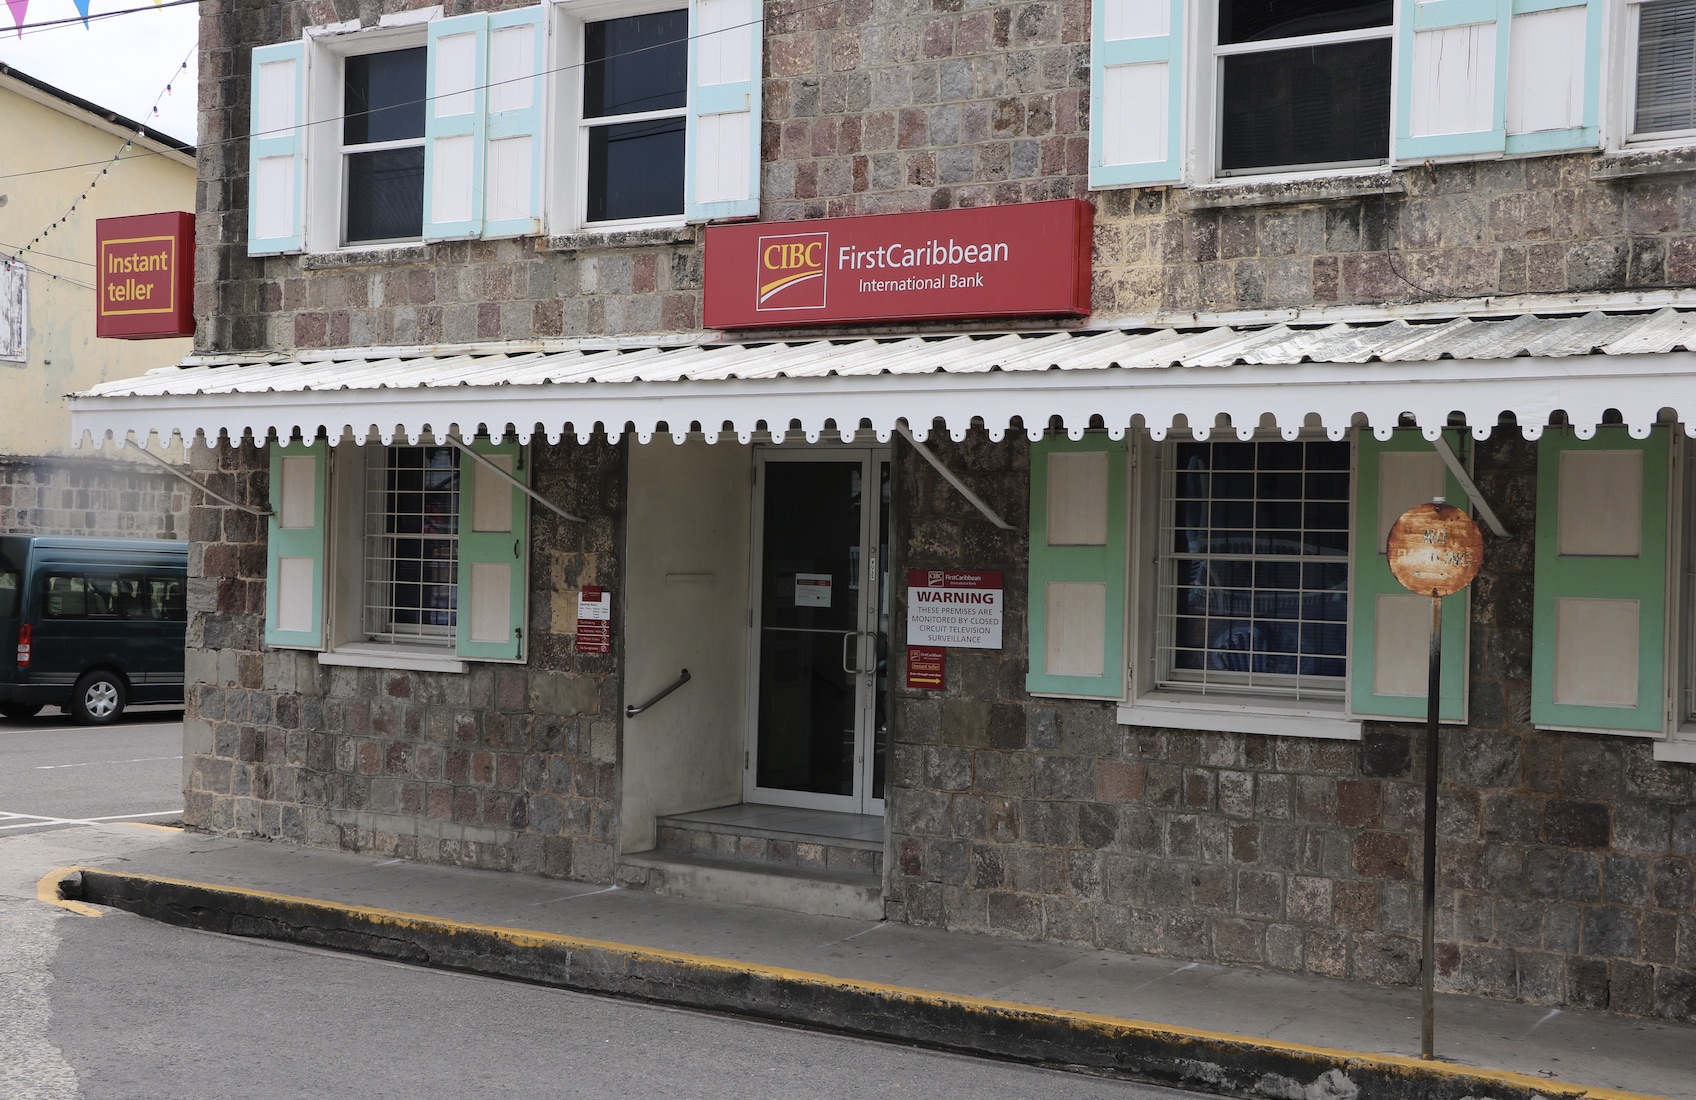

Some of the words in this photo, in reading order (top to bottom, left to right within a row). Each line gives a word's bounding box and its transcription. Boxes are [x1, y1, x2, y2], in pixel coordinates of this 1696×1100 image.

[108, 251, 168, 274] Instant
[763, 242, 822, 270] CIBC
[838, 239, 1009, 270] FirstCaribbean
[107, 279, 154, 301] teller
[859, 274, 945, 293] International
[949, 272, 984, 289] Bank
[1423, 529, 1447, 545] NO
[1397, 547, 1473, 568] PAKING
[917, 591, 994, 604] WARNING
[911, 615, 957, 624] MONITORED
[970, 617, 999, 625] CLOSED
[918, 606, 939, 614] THESE
[941, 607, 976, 615] PREMISES
[978, 608, 993, 616] ARE
[919, 625, 947, 633] CIRCUIT
[949, 626, 991, 634] TELEVISION
[928, 634, 981, 643] SURVEILLANCE
